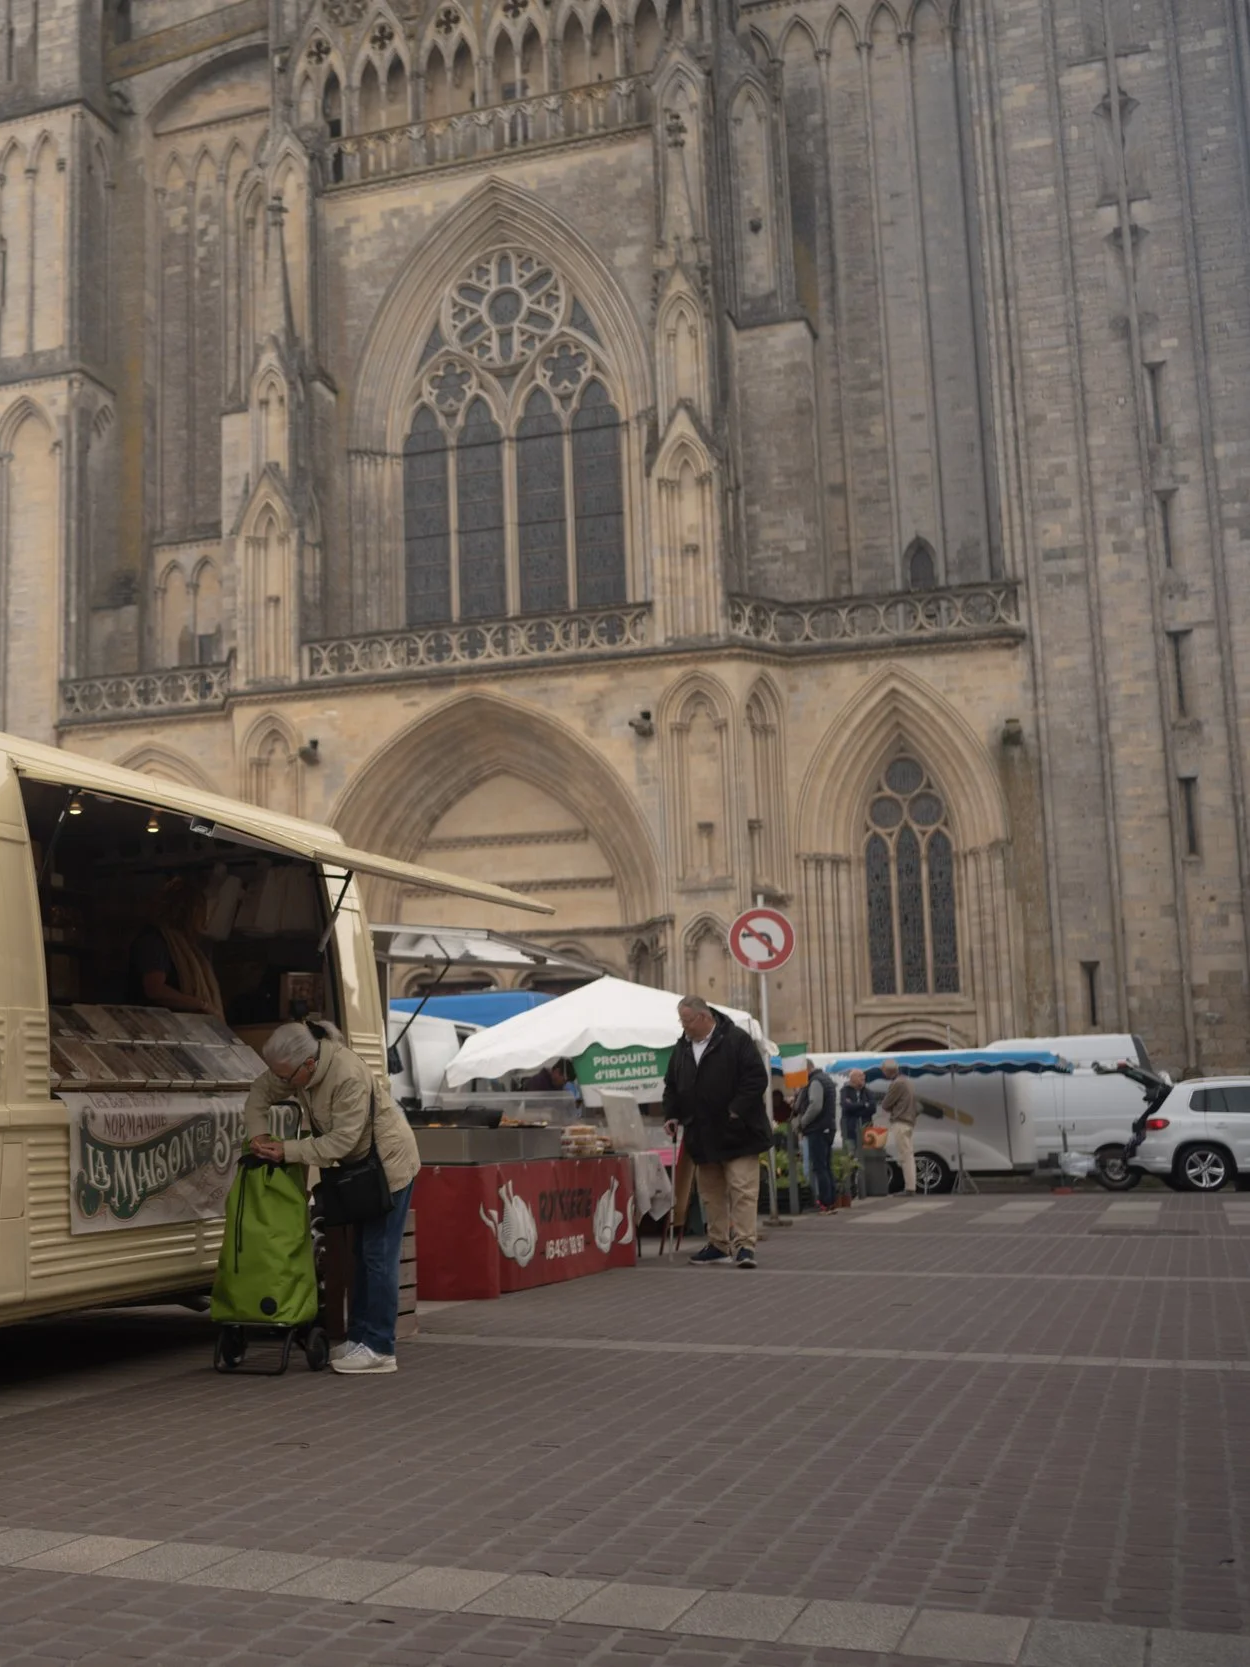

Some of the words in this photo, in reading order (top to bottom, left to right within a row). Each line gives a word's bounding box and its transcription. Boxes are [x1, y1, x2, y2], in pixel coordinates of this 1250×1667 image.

[593, 1051, 656, 1066] PRODUITS
[594, 1065, 658, 1080] d'IRLANDE
[104, 1112, 167, 1139] NORMANDIE
[86, 1143, 111, 1188] LA
[111, 1125, 197, 1208] MAISON
